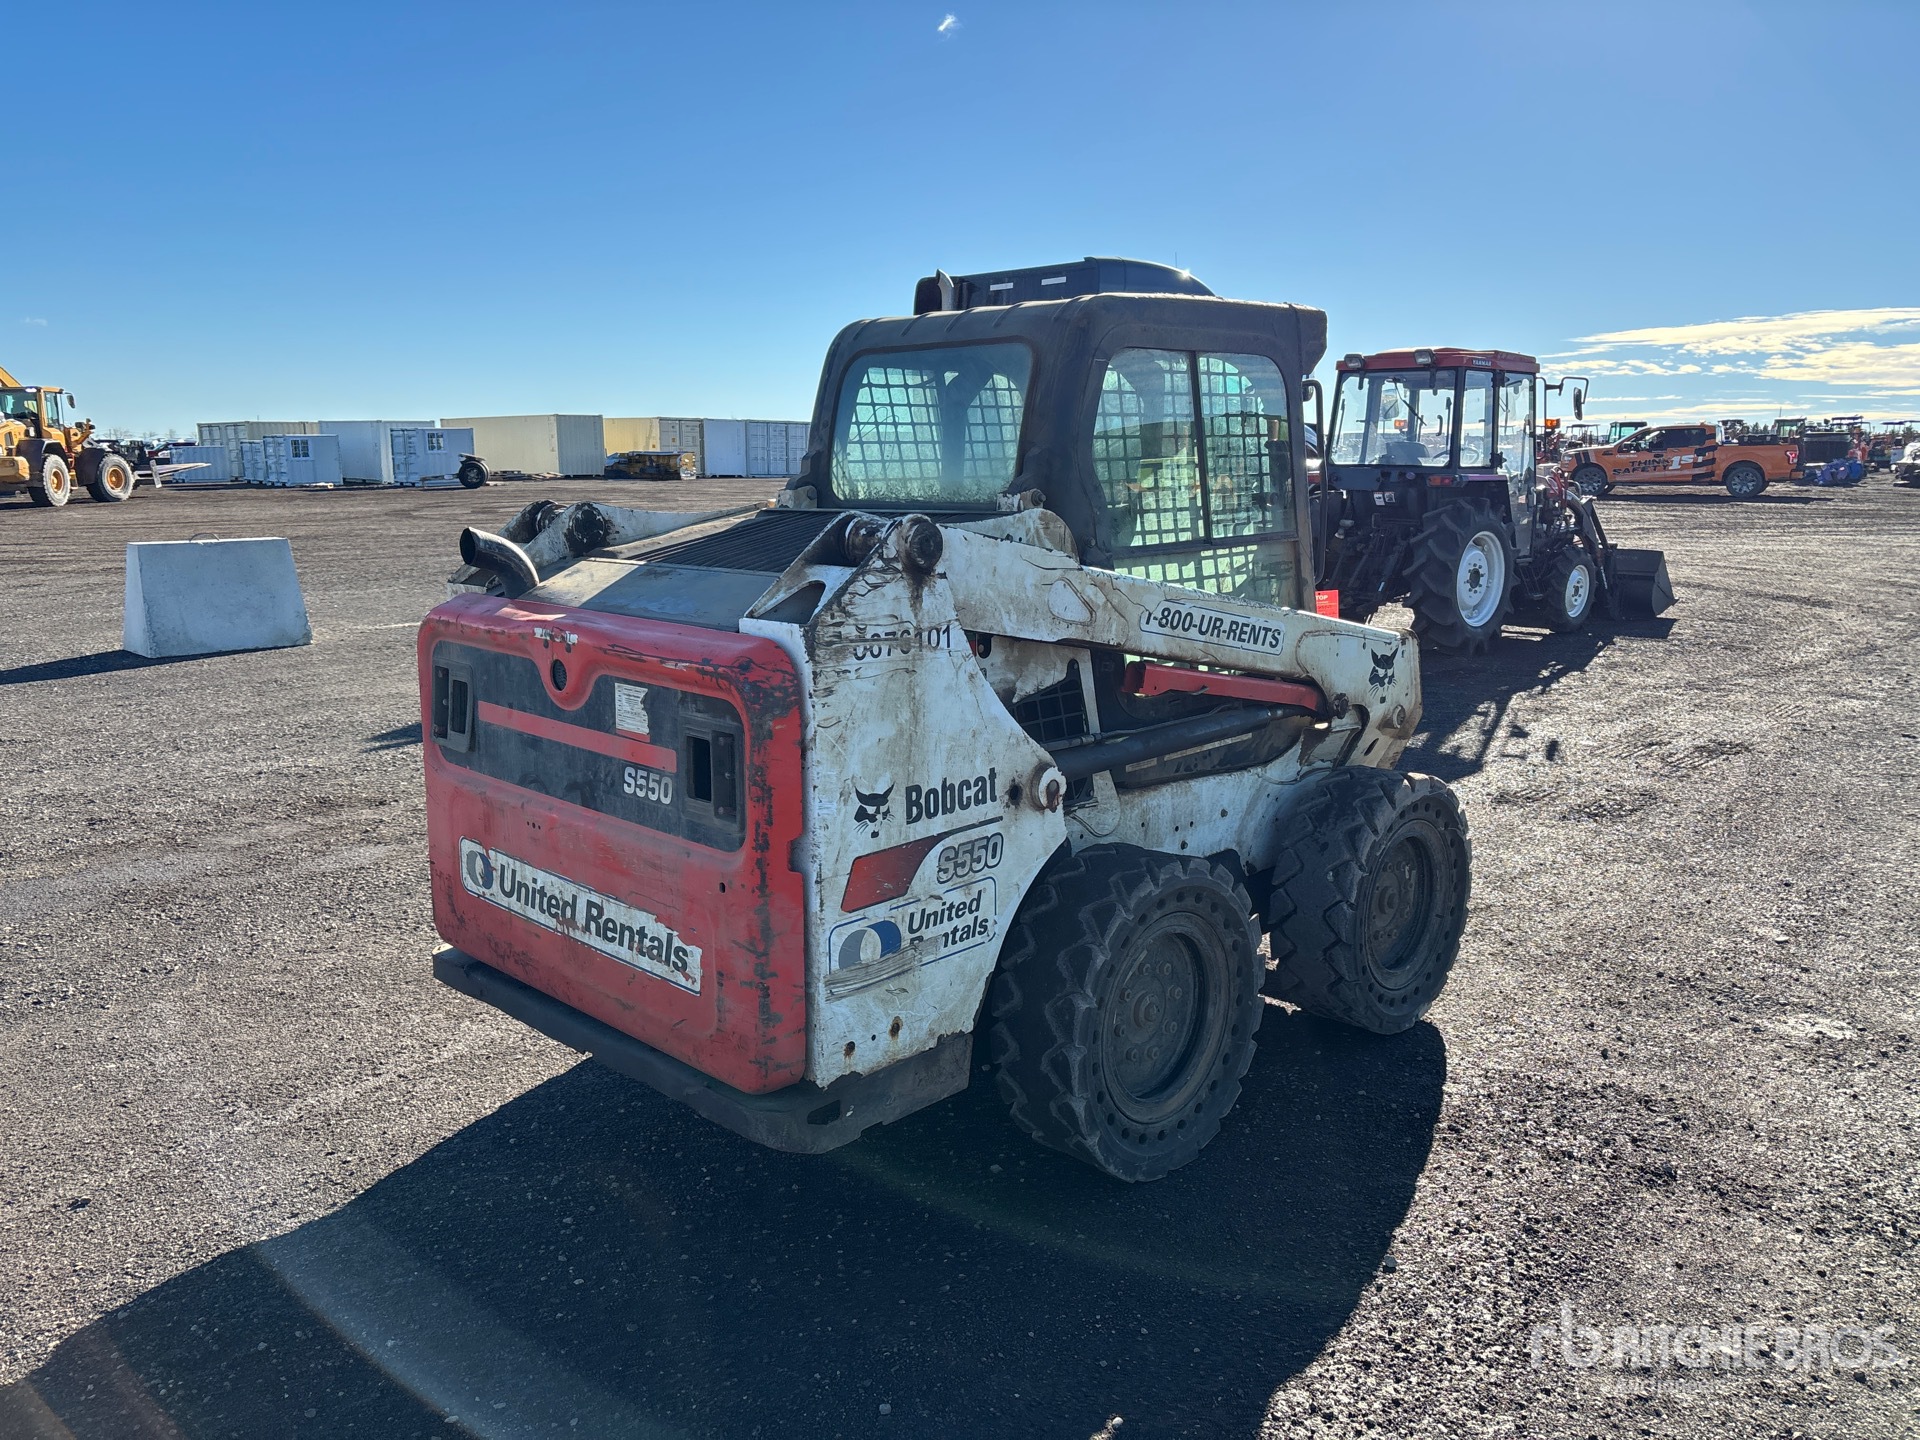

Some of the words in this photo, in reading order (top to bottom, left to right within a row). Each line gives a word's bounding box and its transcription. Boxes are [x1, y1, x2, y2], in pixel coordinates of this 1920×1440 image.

[1612, 464, 1669, 476] SAFETY
[1629, 457, 1671, 468] THINK
[1144, 606, 1282, 650] 1-800-UR-RENTS
[623, 766, 673, 805] S550
[905, 767, 997, 825] Bobcat
[936, 832, 1004, 884] S550
[499, 864, 578, 923] United
[584, 898, 690, 974] Rentals
[907, 889, 982, 935] United
[909, 915, 989, 950] Rntals
